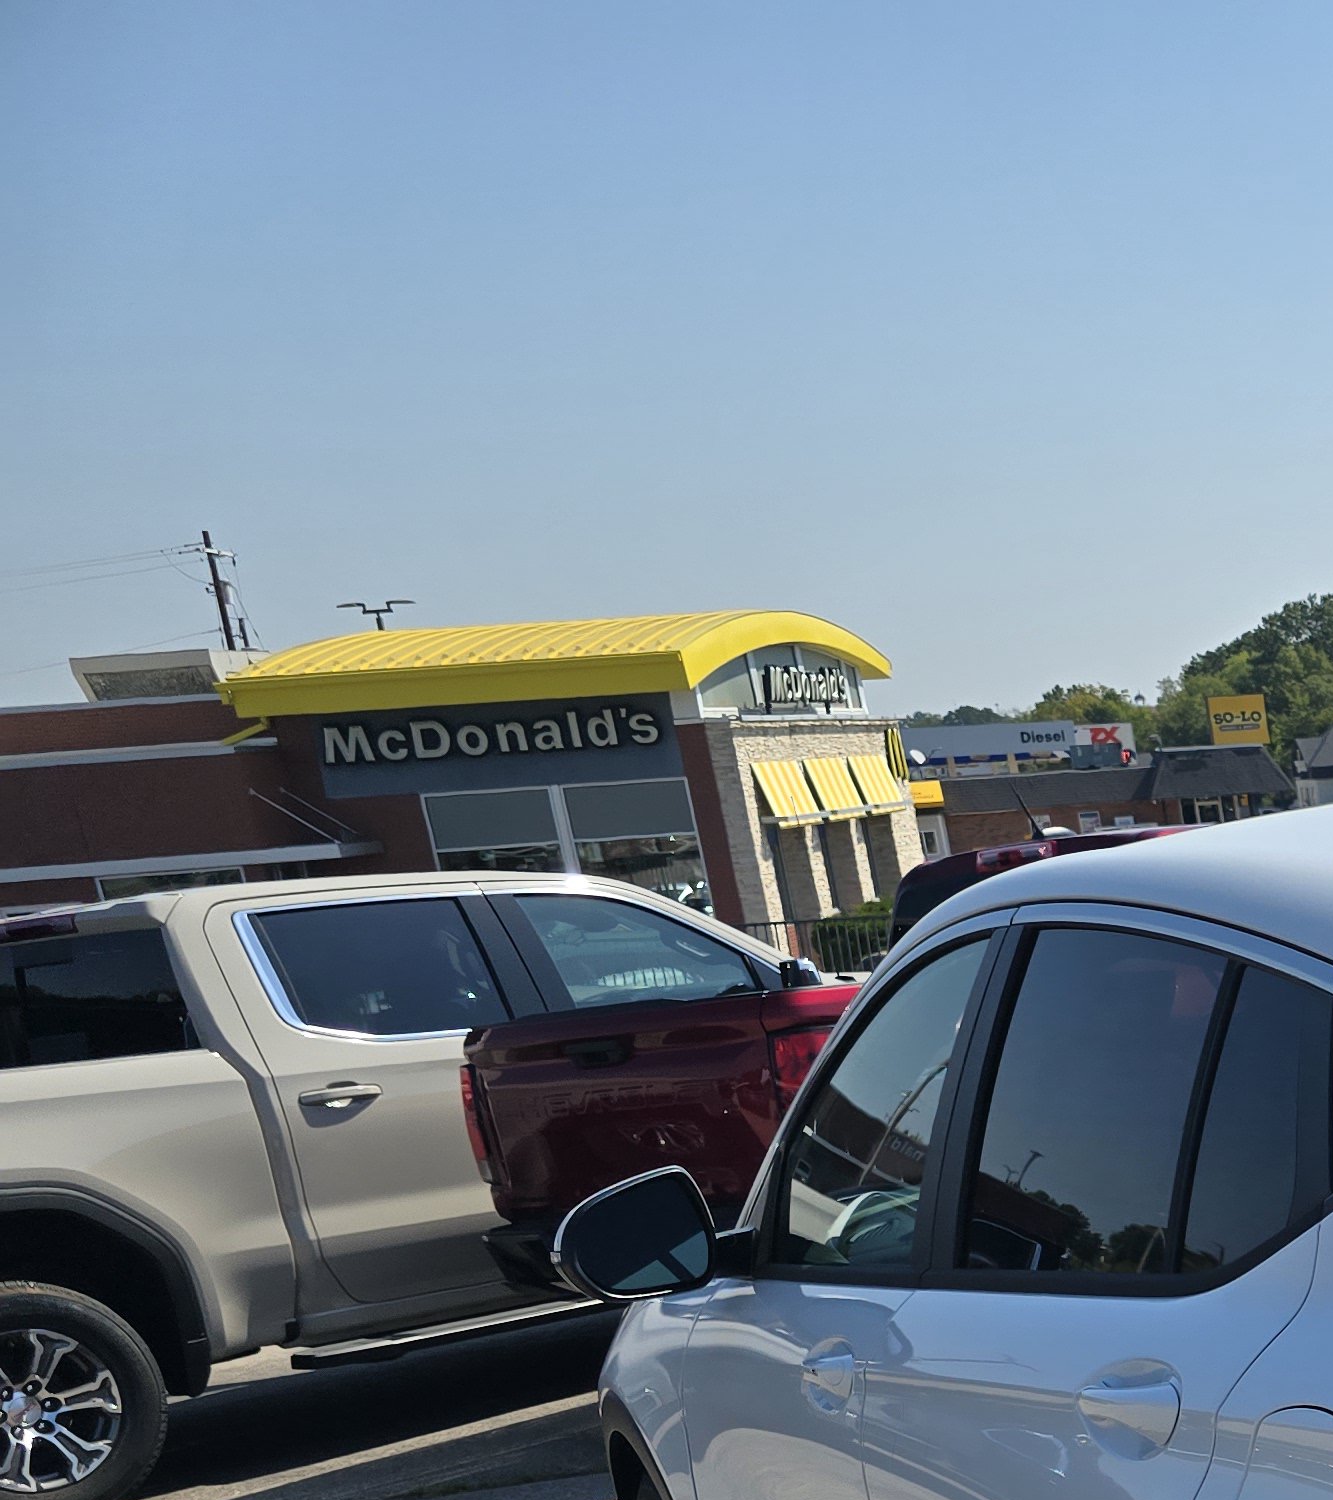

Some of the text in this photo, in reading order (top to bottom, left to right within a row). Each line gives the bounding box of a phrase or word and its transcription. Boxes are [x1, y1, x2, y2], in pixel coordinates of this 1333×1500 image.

[768, 664, 847, 703] McDonald's
[1212, 710, 1262, 725] SO-LO
[322, 706, 660, 766] McDonald's
[1019, 728, 1067, 745] Diesel
